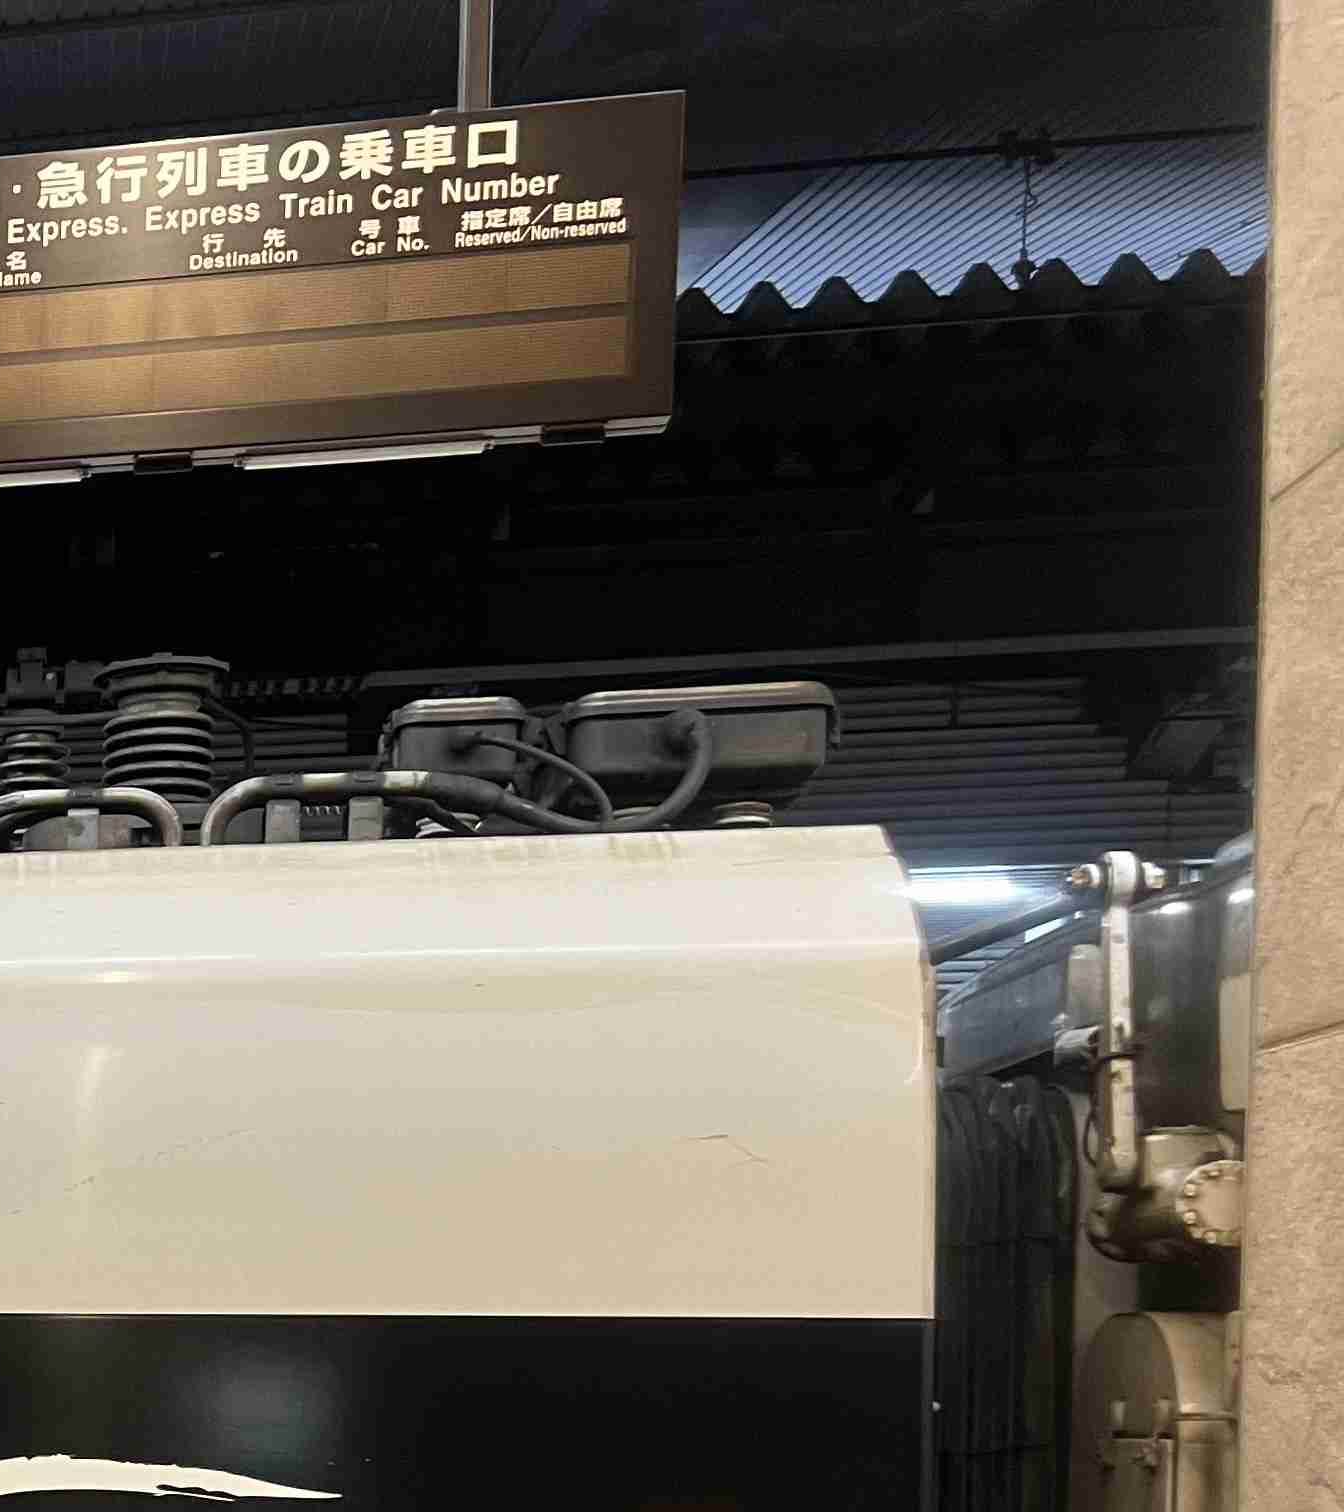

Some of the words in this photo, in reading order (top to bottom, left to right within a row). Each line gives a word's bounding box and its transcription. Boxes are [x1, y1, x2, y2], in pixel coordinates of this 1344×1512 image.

[144, 203, 261, 233] Express
[279, 190, 354, 219] Train
[371, 184, 424, 211] Car
[441, 173, 561, 205] Number
[350, 240, 386, 257] Car
[397, 235, 430, 252] No.
[189, 248, 298, 271] Destination
